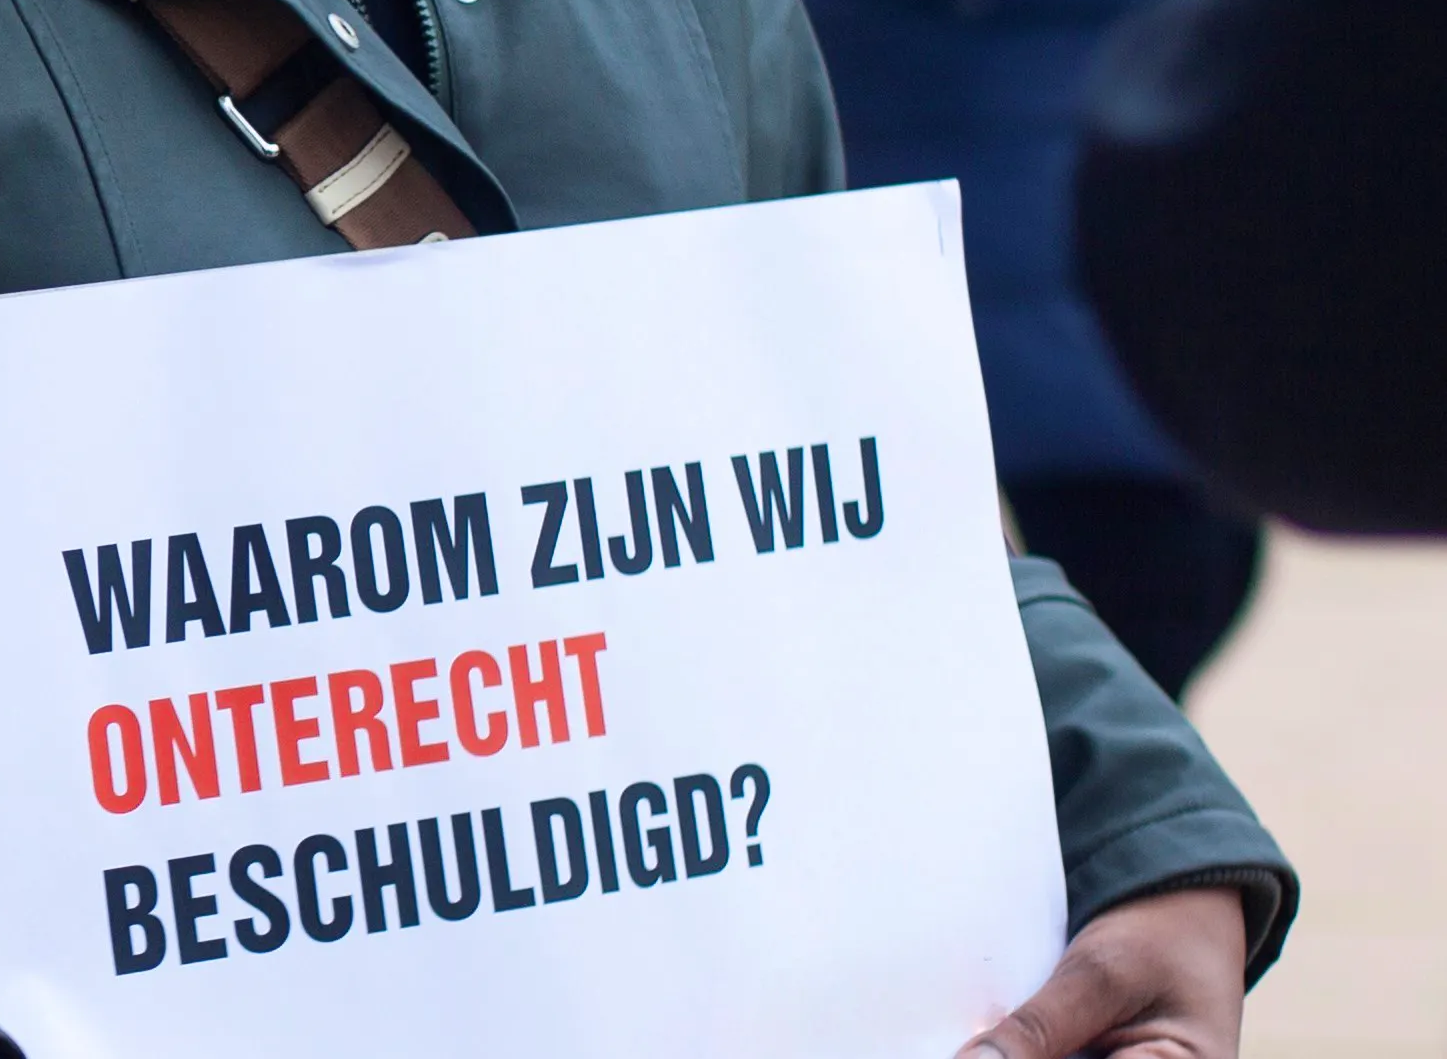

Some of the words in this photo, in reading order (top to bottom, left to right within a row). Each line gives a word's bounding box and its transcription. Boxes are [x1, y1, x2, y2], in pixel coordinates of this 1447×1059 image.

[61, 490, 499, 655] WAAROM
[520, 460, 716, 589] ZIJN
[730, 436, 885, 555] WIJ
[87, 631, 608, 816] ONTERECHT
[102, 762, 772, 977] BESCHULDIGD?
